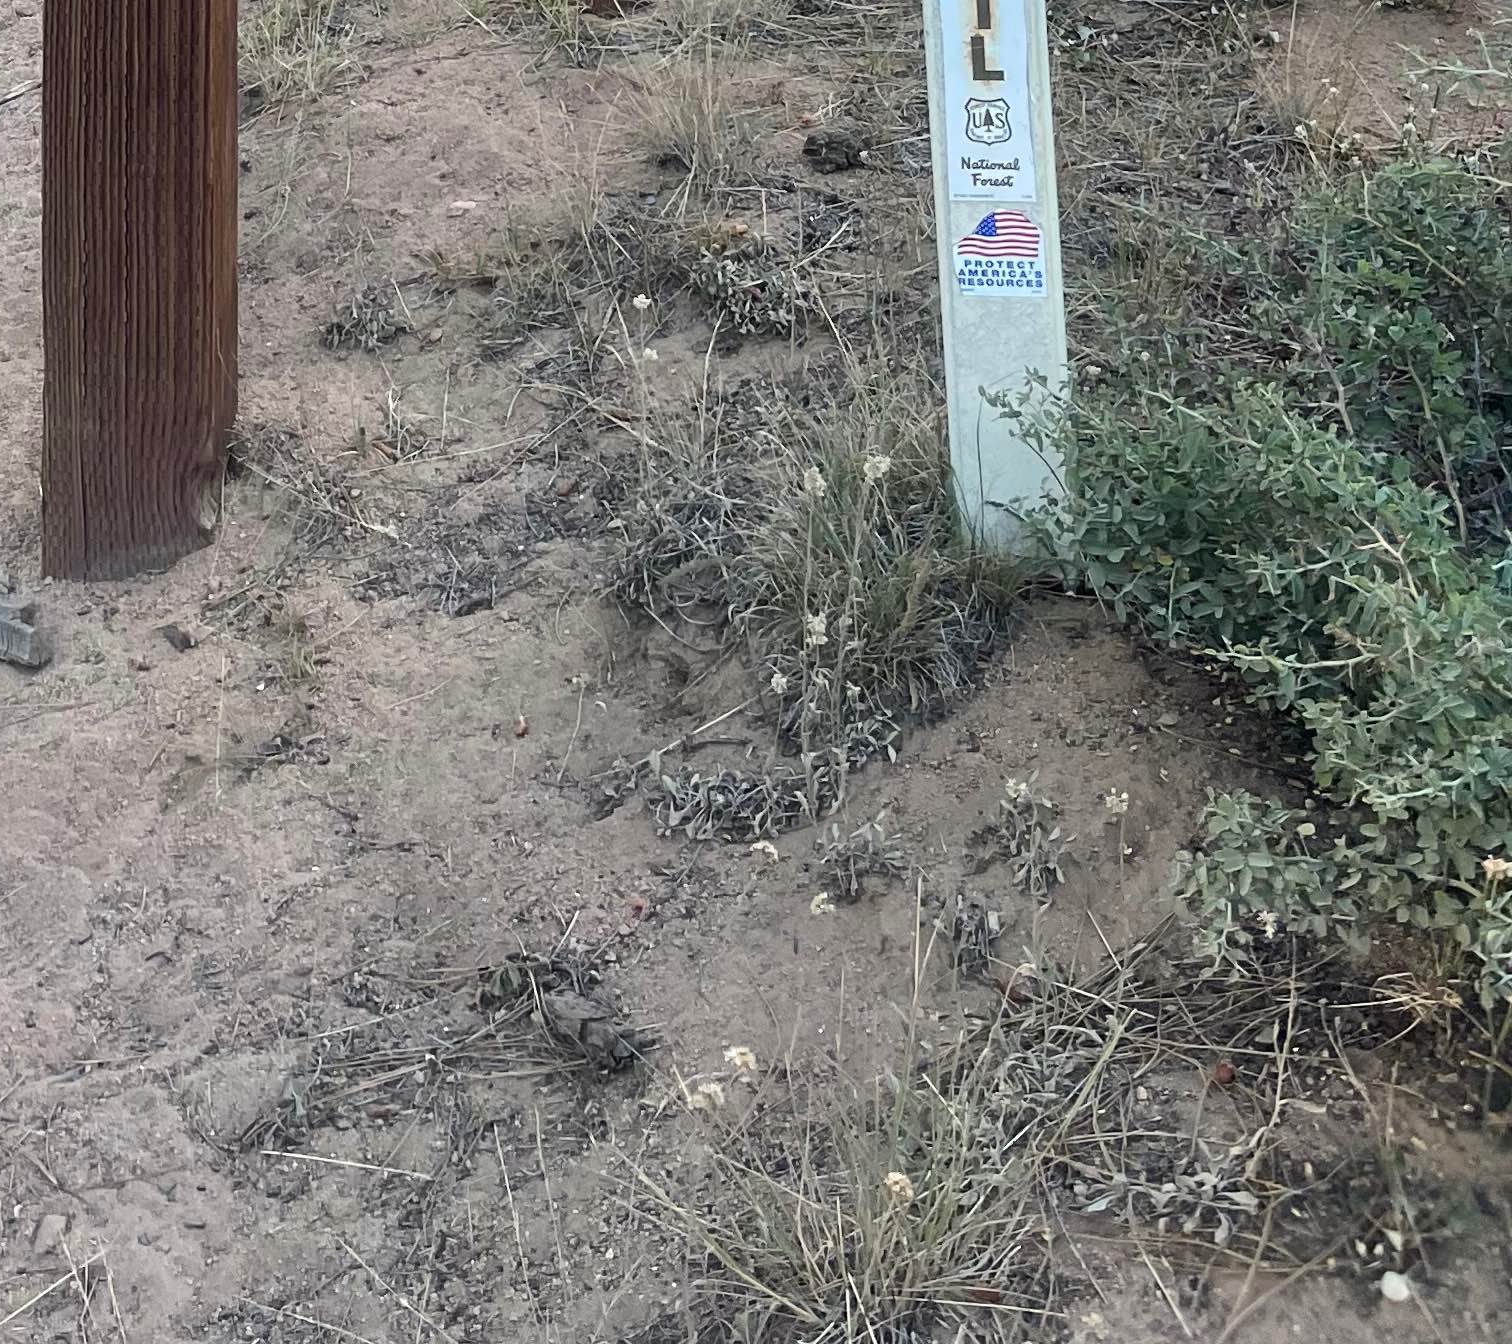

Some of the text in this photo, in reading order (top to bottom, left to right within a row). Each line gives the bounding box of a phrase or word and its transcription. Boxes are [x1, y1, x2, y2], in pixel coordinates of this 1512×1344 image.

[961, 156, 1020, 171] National
[971, 173, 1014, 187] Forest
[964, 259, 1035, 269] PROTECT
[958, 268, 1042, 278] AMERICA'S
[958, 278, 1043, 288] RESOURCES
